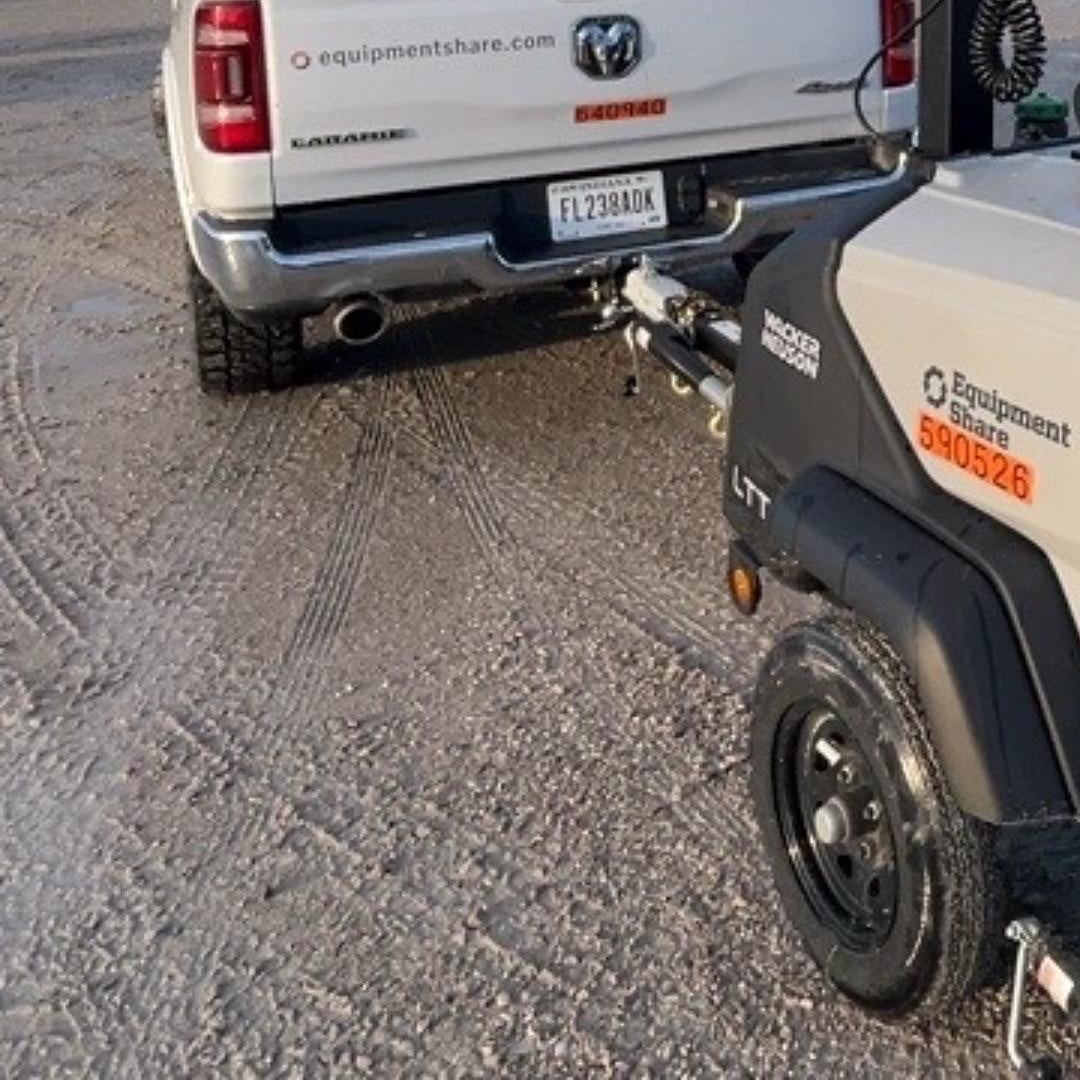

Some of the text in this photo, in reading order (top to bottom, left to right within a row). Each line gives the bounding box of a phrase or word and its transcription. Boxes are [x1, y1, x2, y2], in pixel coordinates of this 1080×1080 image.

[319, 33, 556, 67] equipmentshare.com
[949, 400, 1009, 450] Share
[951, 370, 1072, 448] Equipment
[919, 415, 1030, 500] 590526
